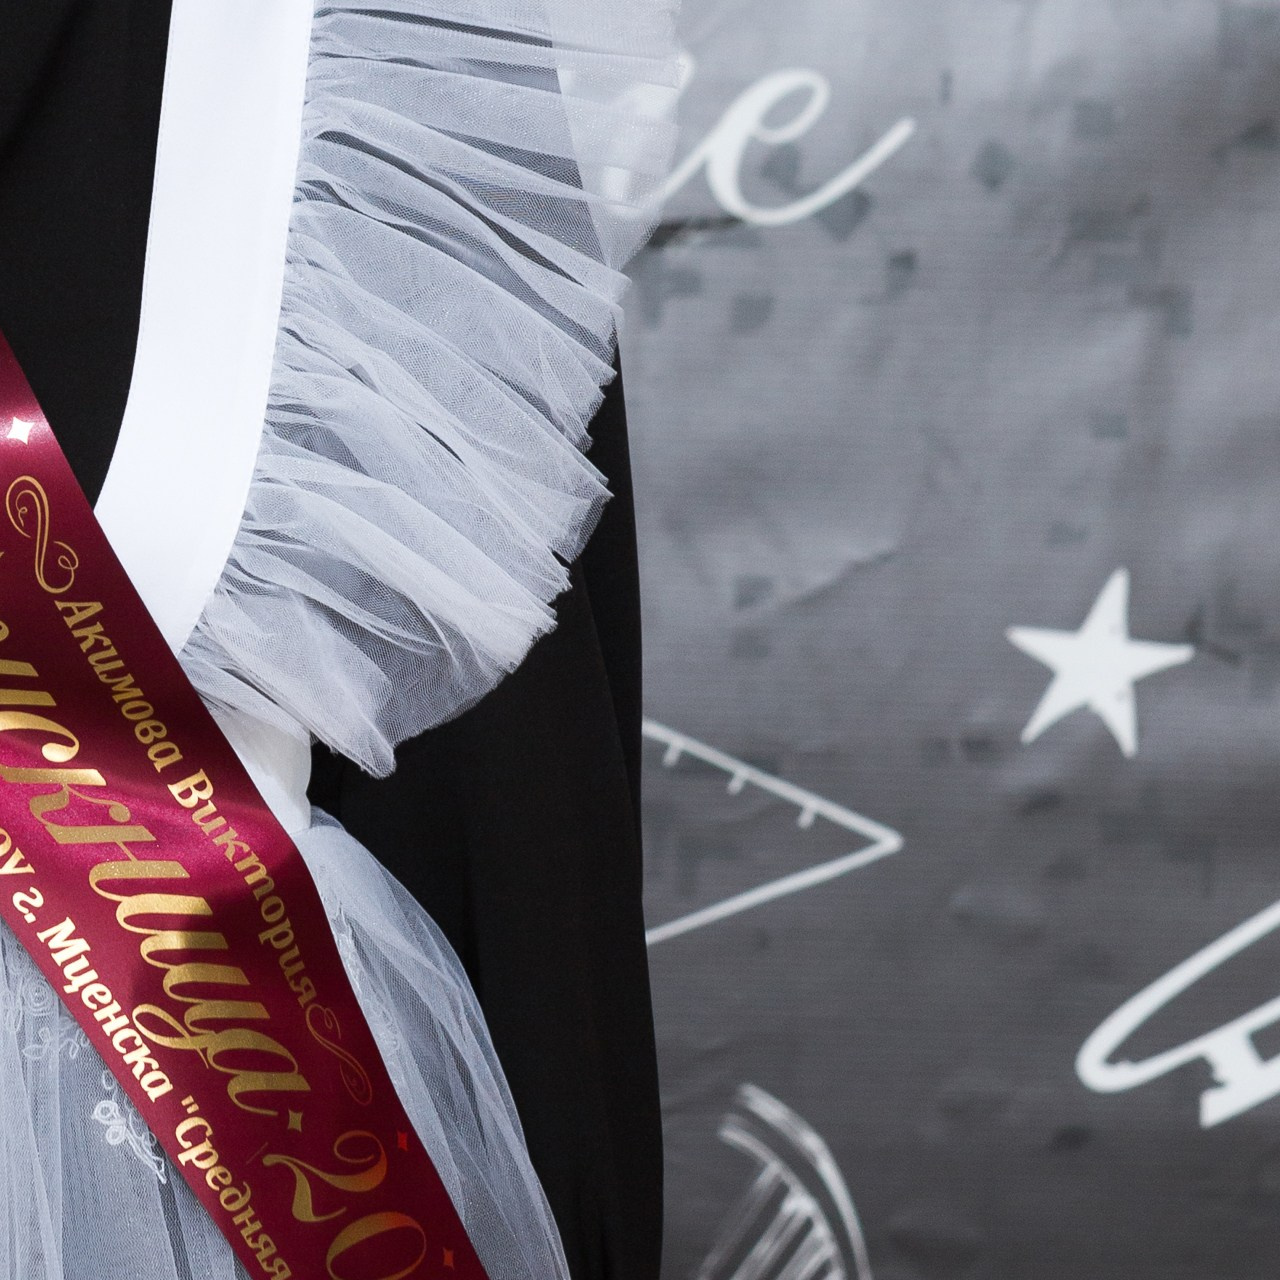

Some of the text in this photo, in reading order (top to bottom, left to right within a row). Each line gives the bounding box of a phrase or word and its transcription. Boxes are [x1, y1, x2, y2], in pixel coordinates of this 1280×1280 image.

[54, 599, 319, 1008] Акимова Виктория
[12, 886, 45, 924] г.
[36, 916, 175, 1104] Мценска
